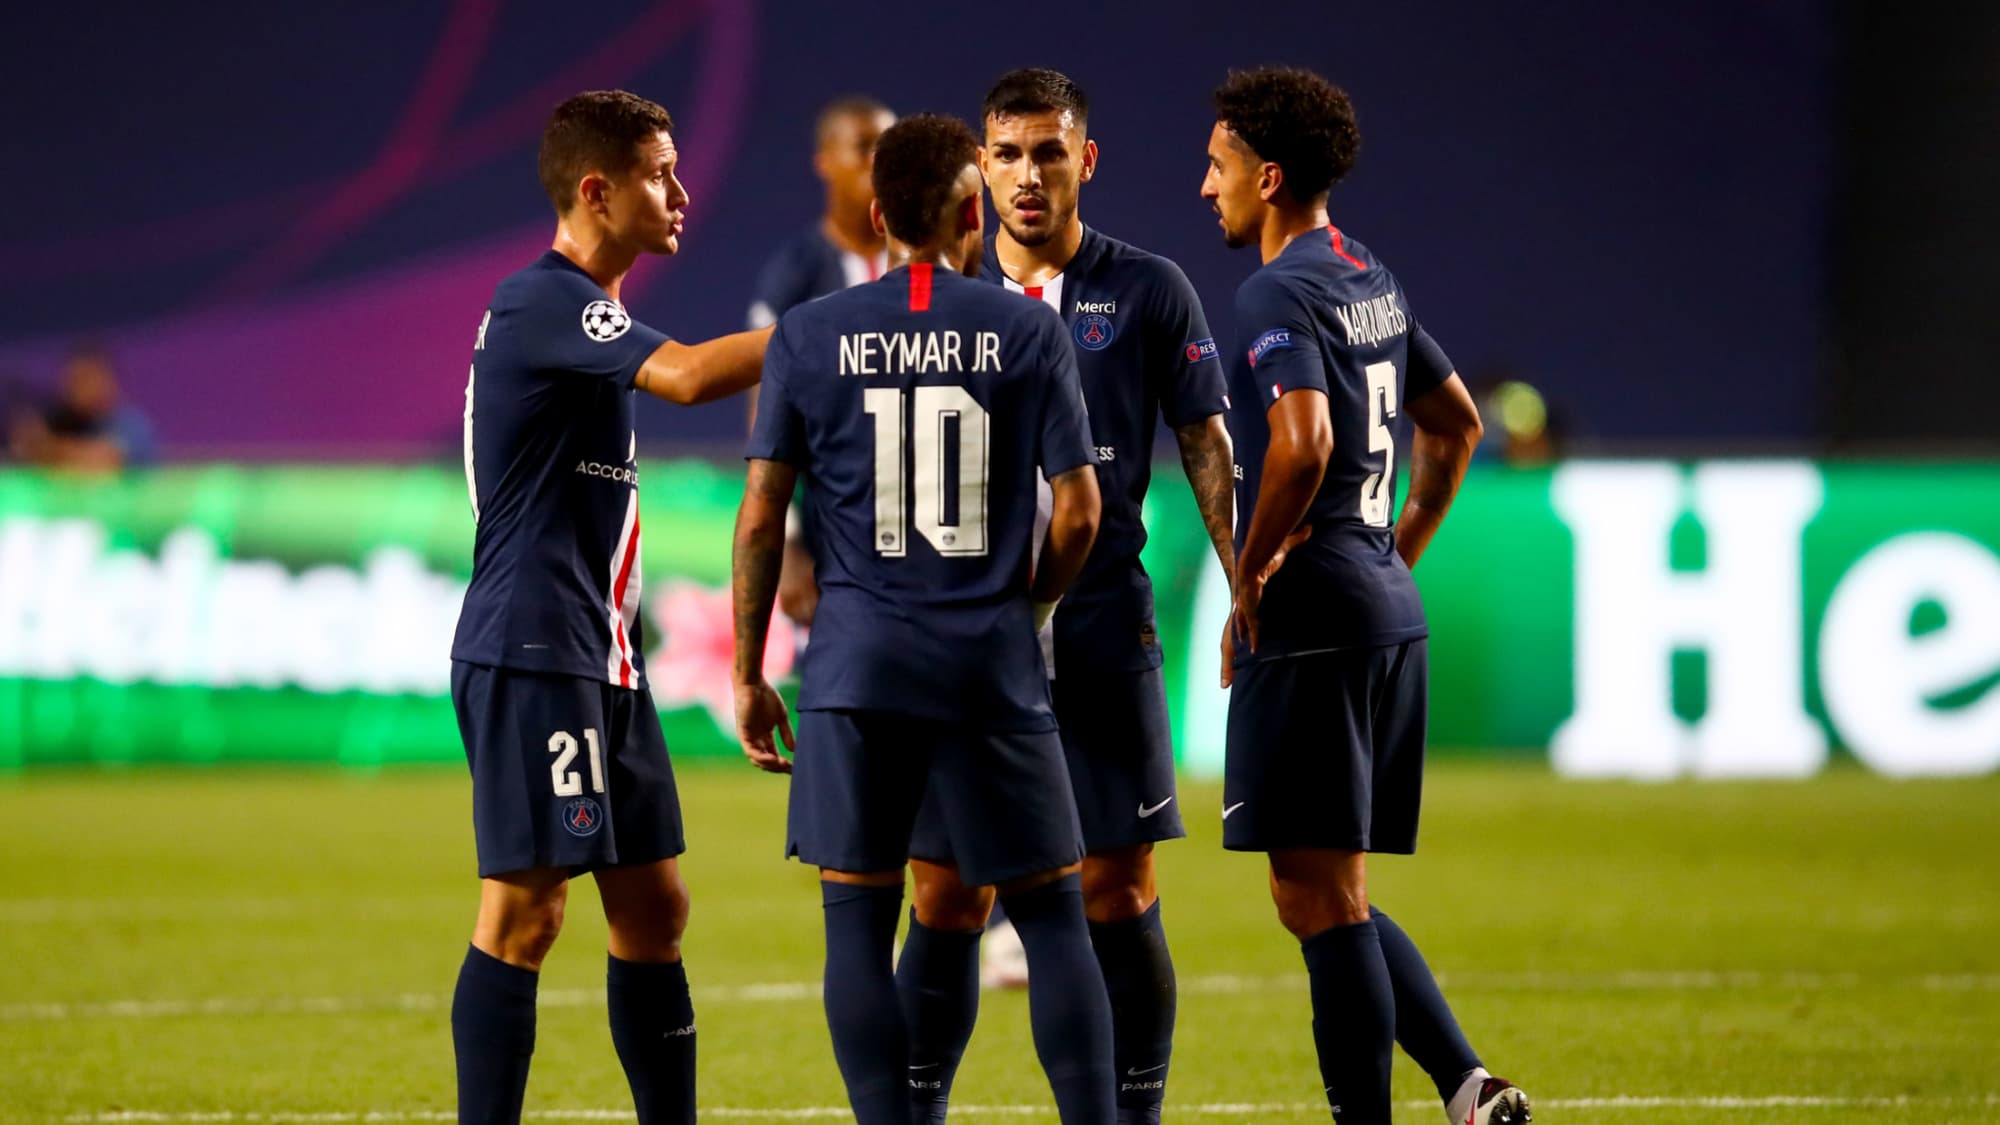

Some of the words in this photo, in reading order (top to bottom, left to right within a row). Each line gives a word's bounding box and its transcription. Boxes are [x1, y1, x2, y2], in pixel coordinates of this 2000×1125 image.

[1075, 300, 1116, 314] Merci
[839, 331, 963, 376] NEYMAR
[971, 332, 1002, 373] JR
[1254, 332, 1290, 355] RESPECT
[864, 385, 990, 557] 10
[1360, 361, 1397, 527] 5
[1549, 461, 2000, 779] He
[547, 728, 605, 797] 21
[1121, 1080, 1164, 1091] PARIS
